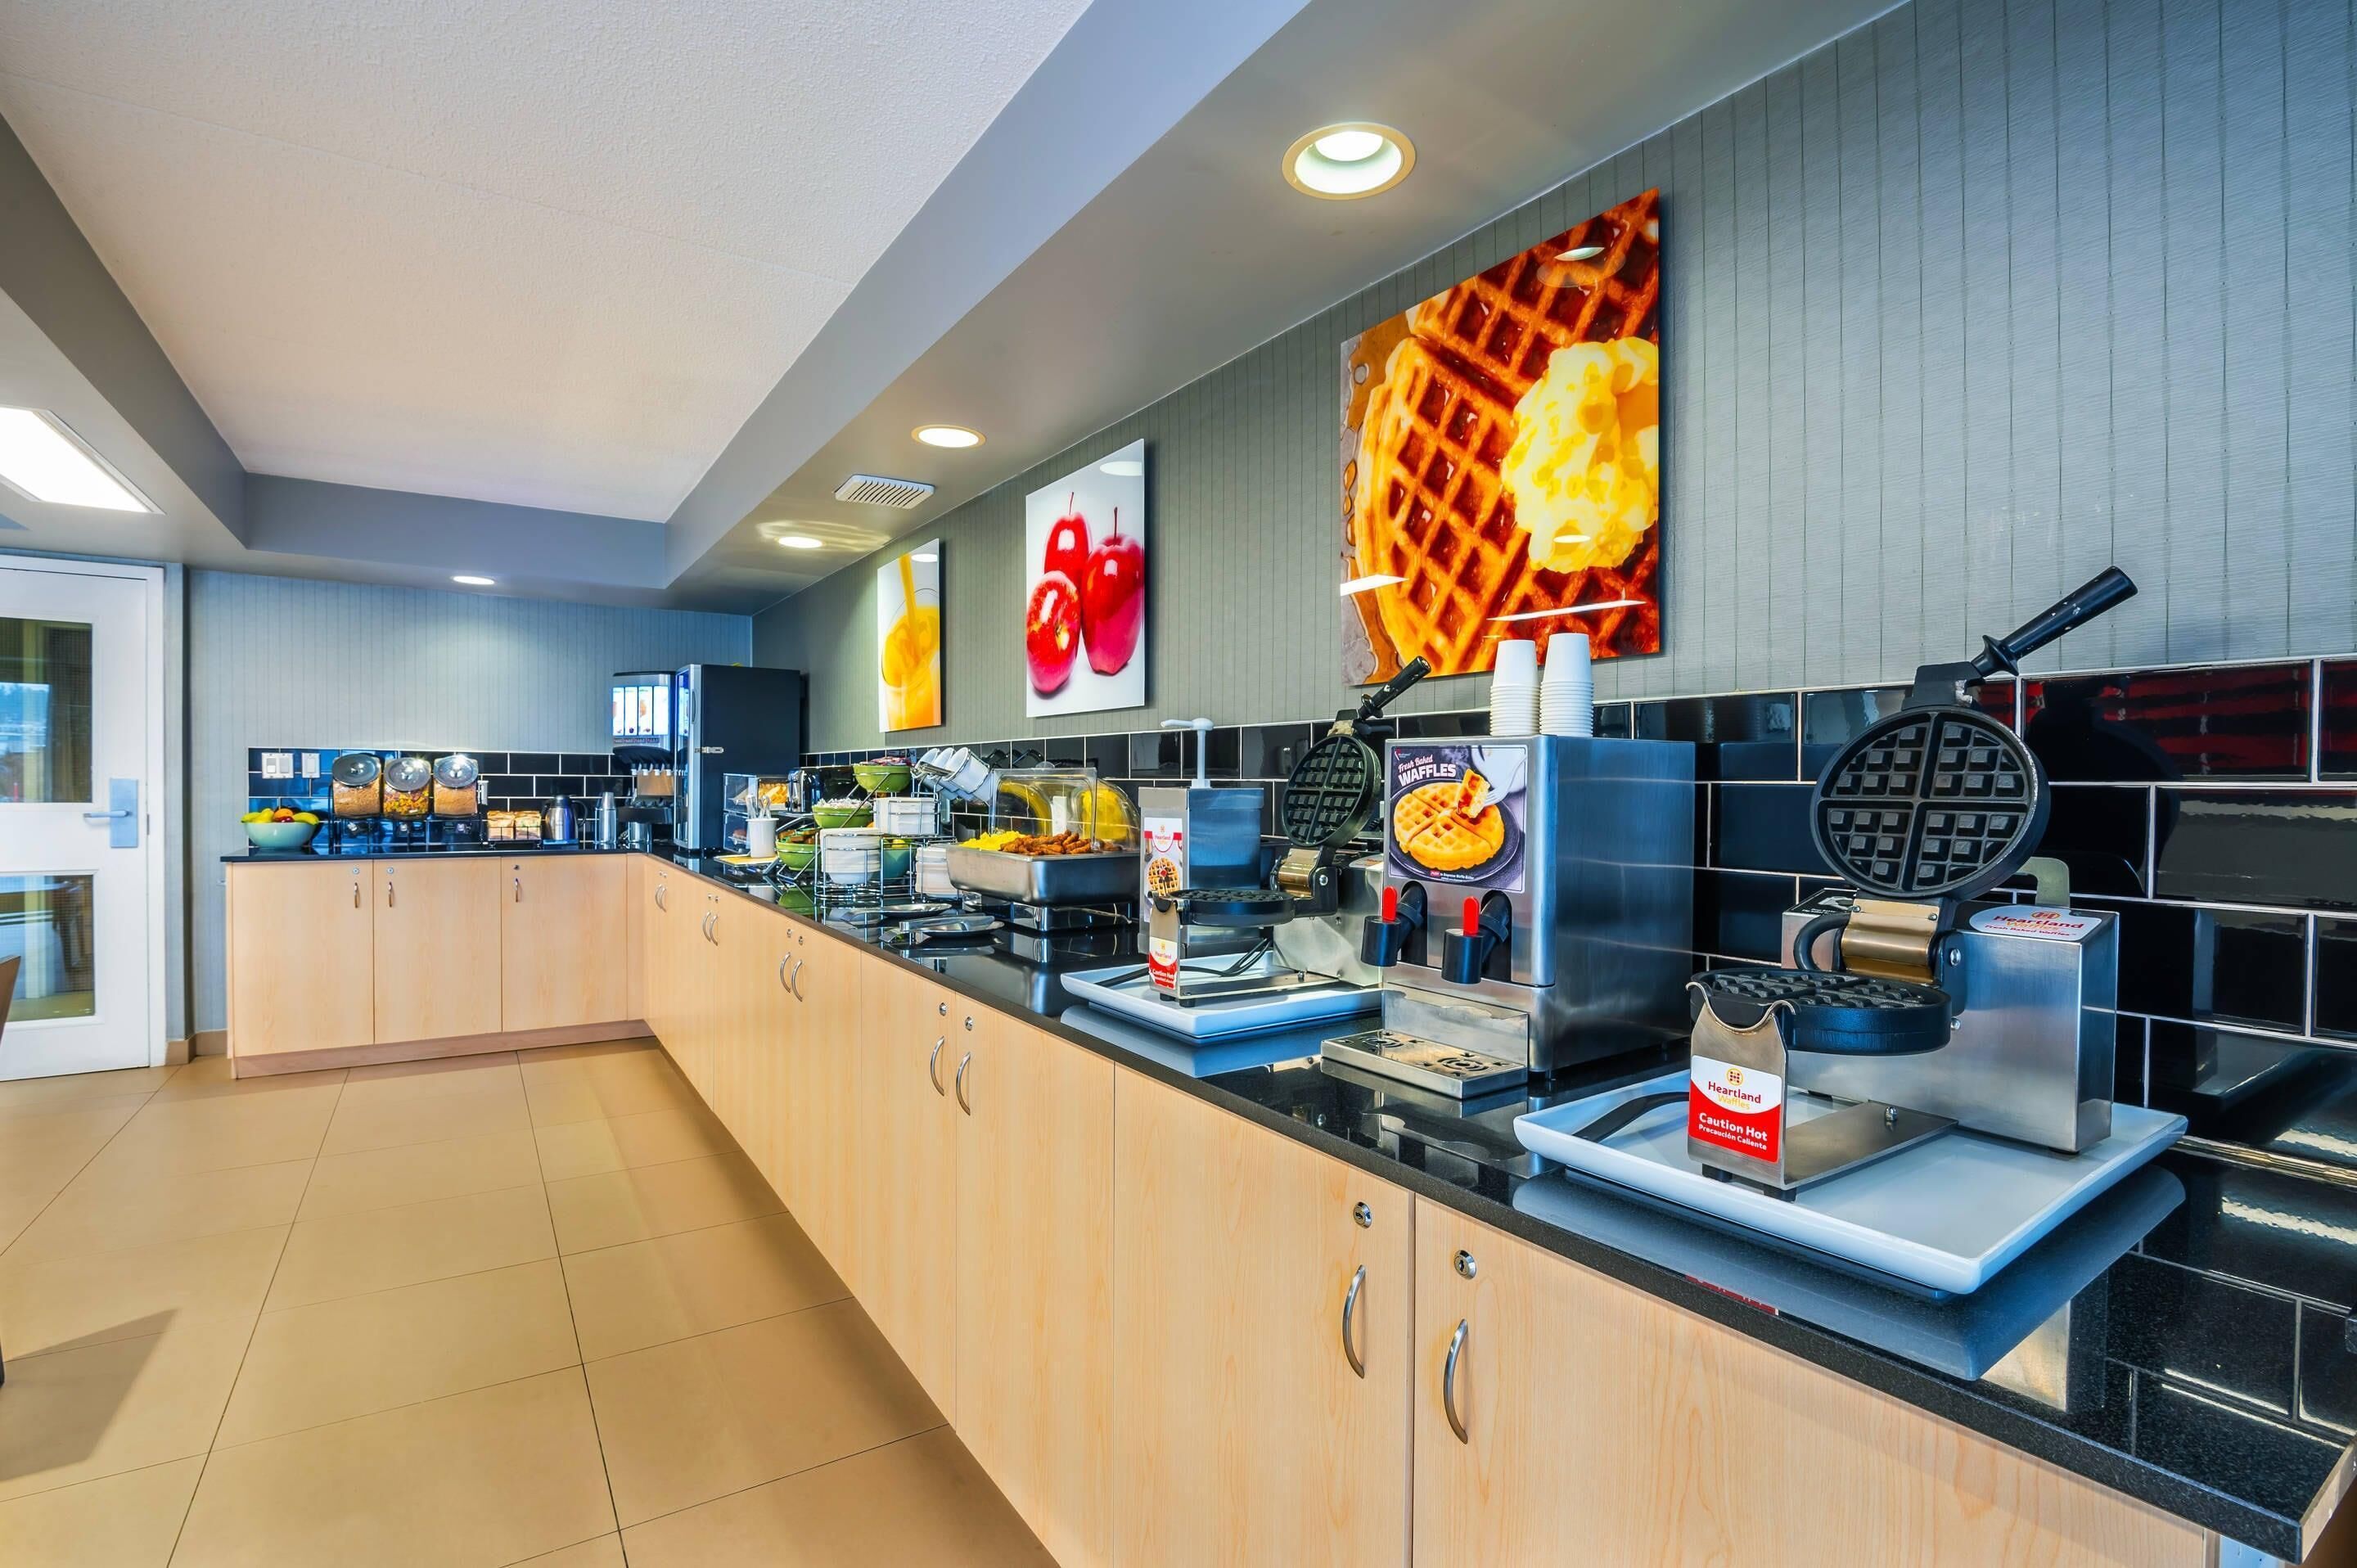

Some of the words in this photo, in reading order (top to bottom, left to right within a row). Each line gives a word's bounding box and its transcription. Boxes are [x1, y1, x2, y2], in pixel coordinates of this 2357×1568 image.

[1398, 760, 1414, 773] Fresh
[1414, 754, 1433, 766] Baked
[1398, 763, 1457, 786] WAFFLES
[1993, 916, 2084, 929] Heartland
[1708, 1081, 1761, 1104] Heartland
[1718, 1094, 1750, 1110] Waffles
[1698, 1124, 1737, 1141] Precaución
[1737, 1135, 1768, 1151] Caliente
[1699, 1113, 1744, 1134] Caution
[1746, 1125, 1768, 1142] Hot
